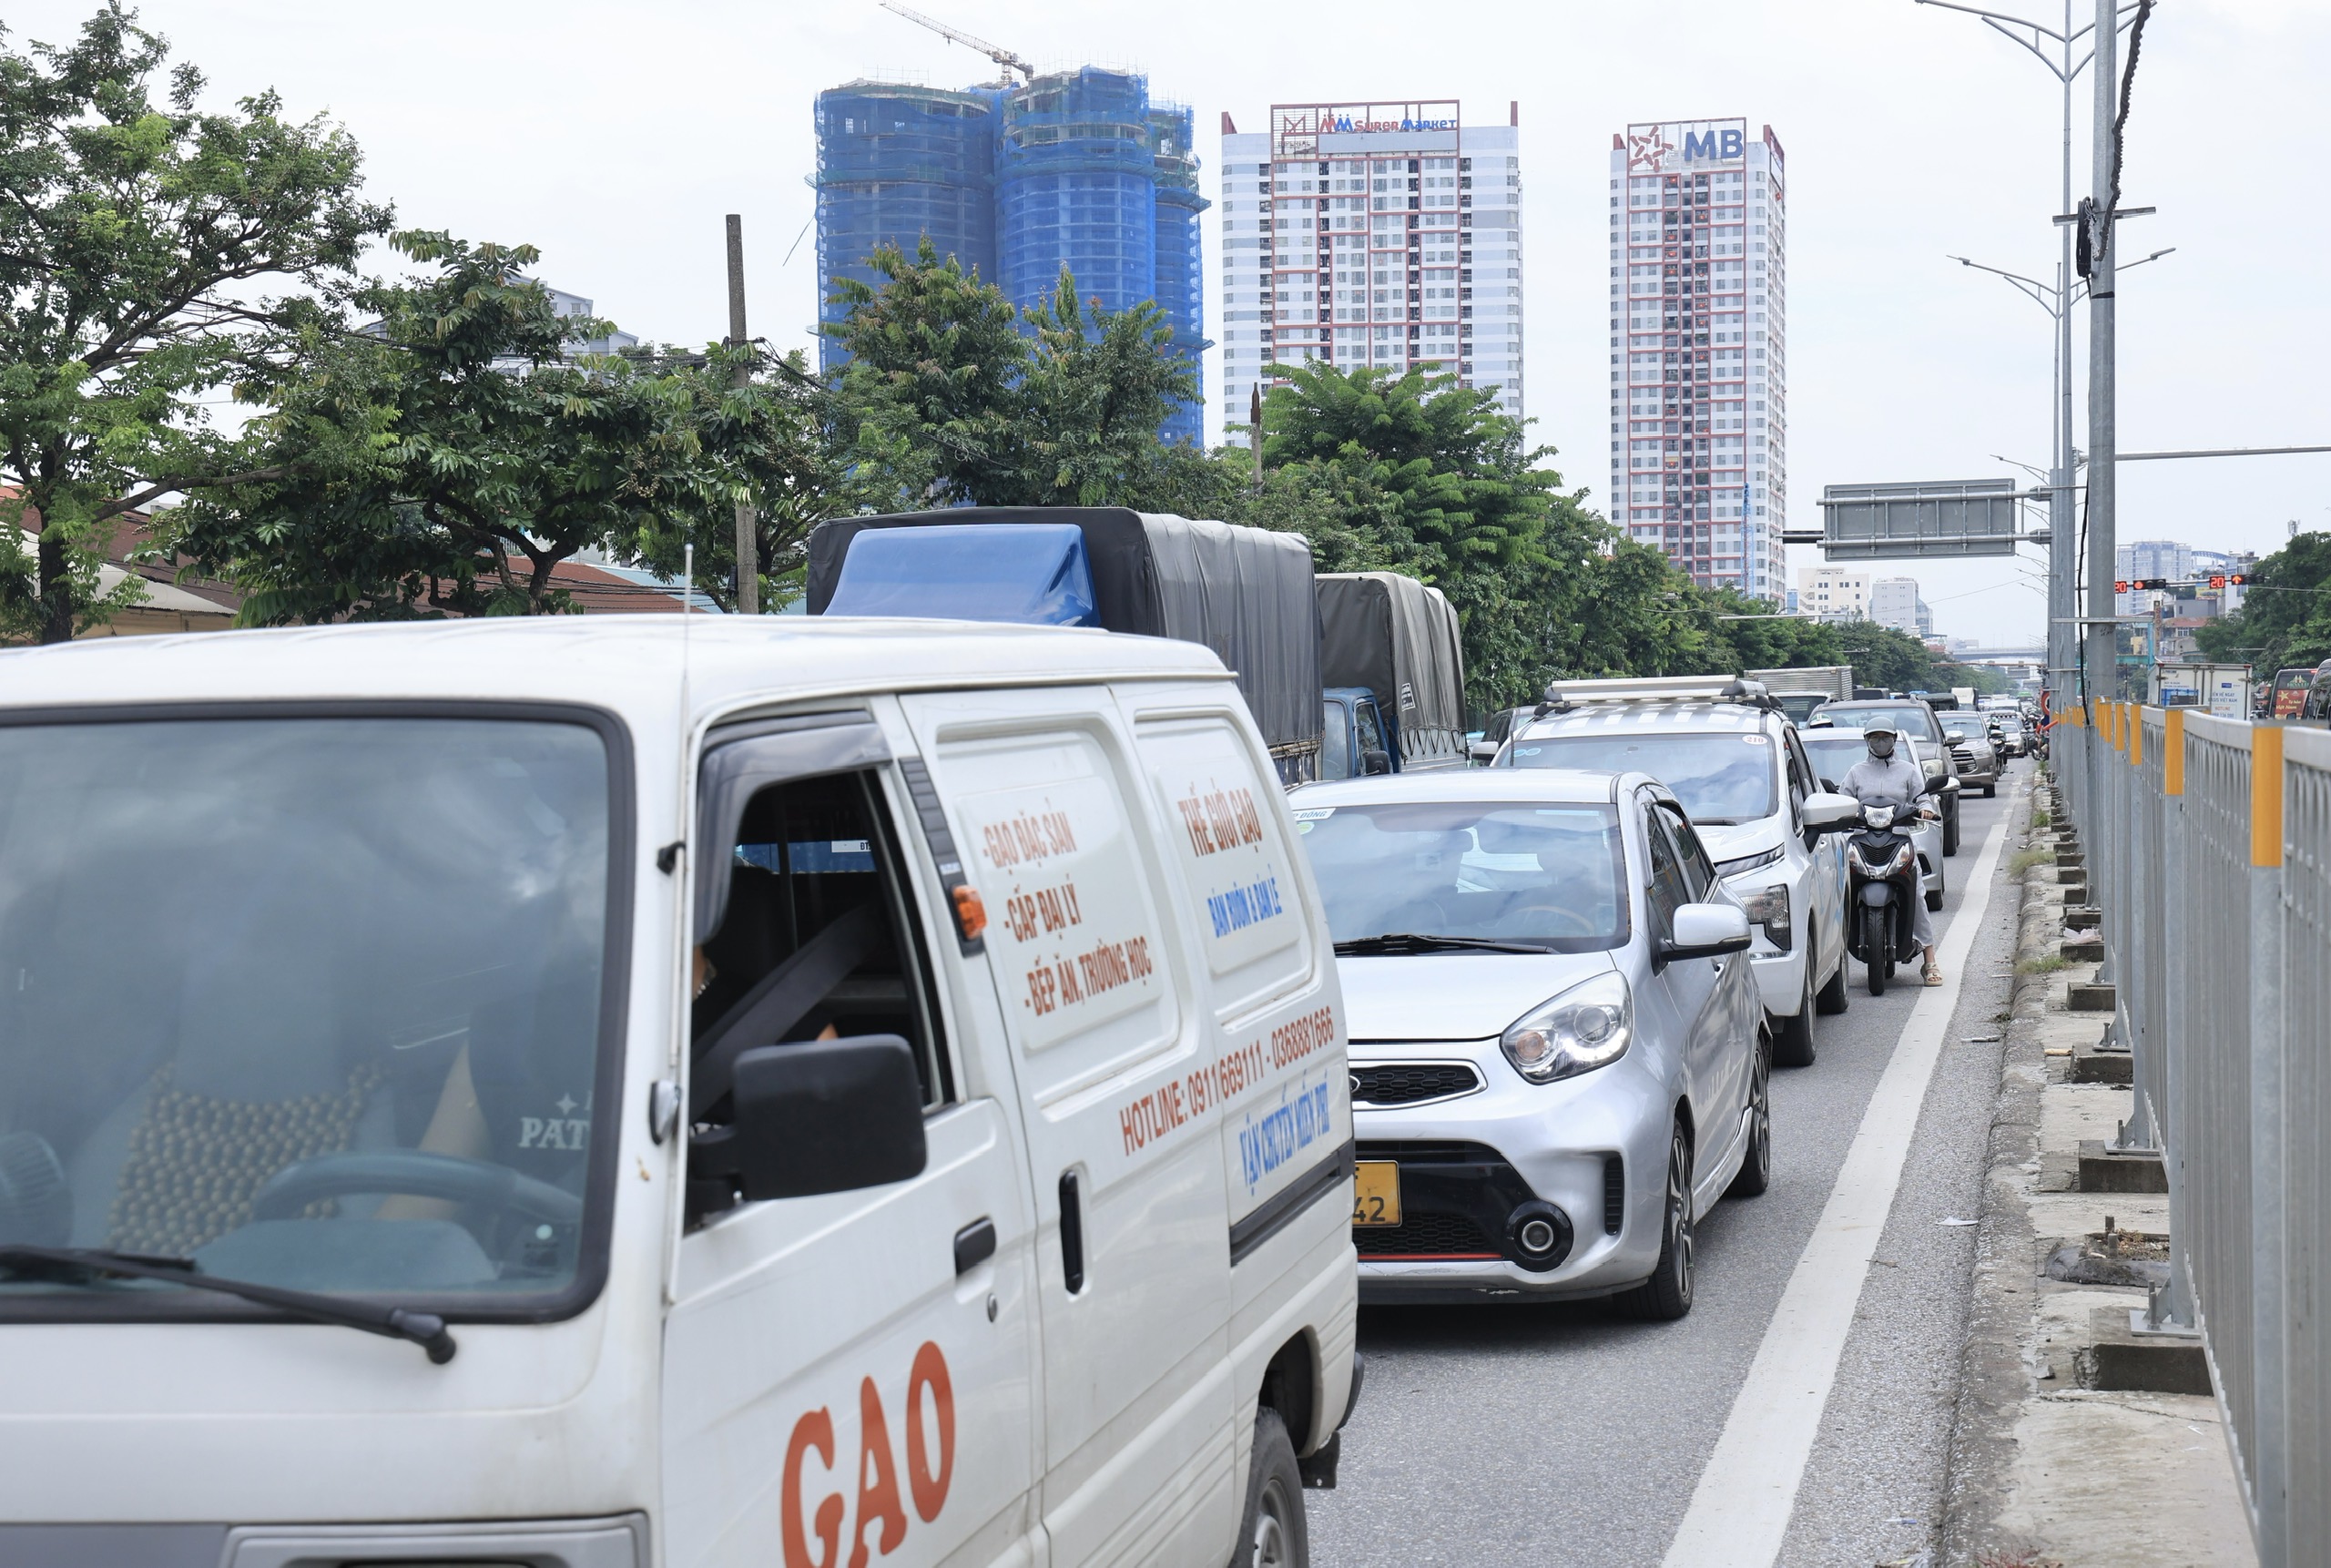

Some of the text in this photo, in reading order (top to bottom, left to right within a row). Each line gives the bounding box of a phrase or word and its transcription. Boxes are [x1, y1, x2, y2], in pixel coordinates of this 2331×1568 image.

[1319, 115, 1353, 131] MM
[1685, 129, 1744, 161] MB
[2211, 577, 2224, 588] 20
[1013, 809, 1049, 868] ĐẶC
[1177, 777, 1263, 858] THẾ GIỚI GẠO
[1035, 887, 1067, 941] ĐẠI
[1061, 873, 1082, 925] LÝ
[1125, 935, 1153, 986] HỌC
[1119, 1080, 1188, 1157] HOTLINE:
[1271, 1005, 1334, 1070] 0368881666
